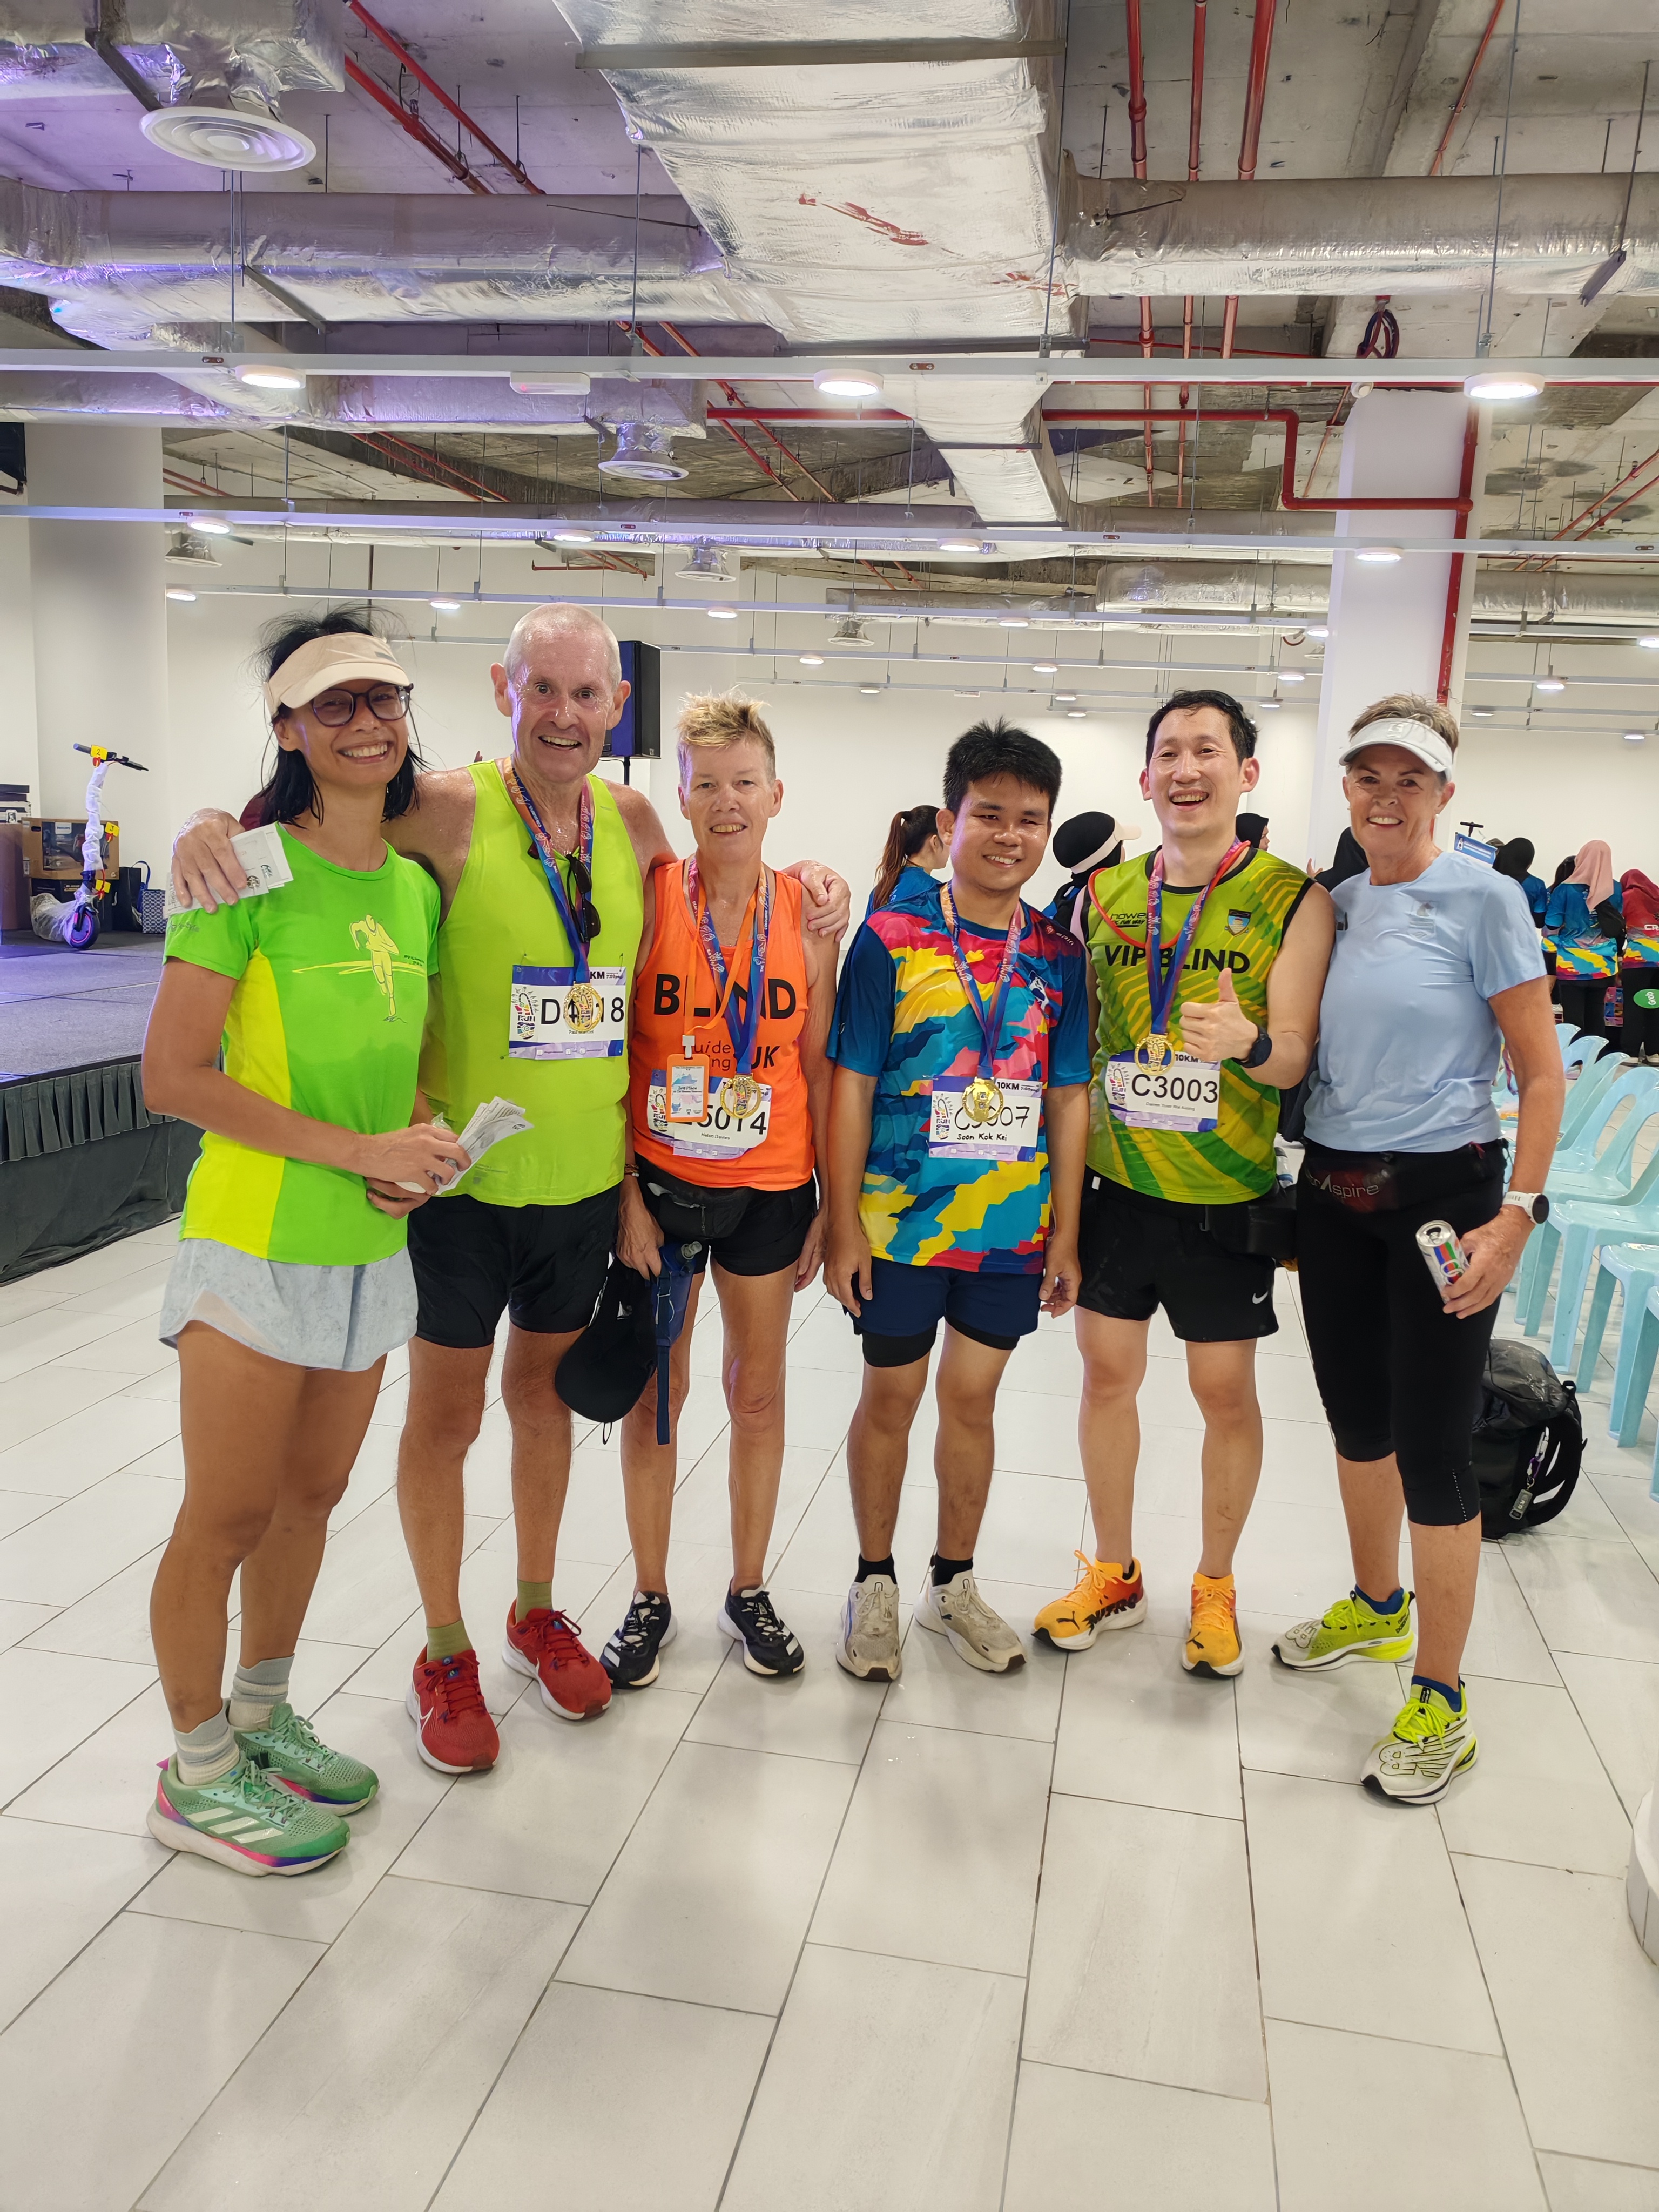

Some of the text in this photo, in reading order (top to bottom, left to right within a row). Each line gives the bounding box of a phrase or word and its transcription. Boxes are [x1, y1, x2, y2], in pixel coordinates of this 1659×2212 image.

[1105, 945, 1147, 967] VIP
[1645, 992, 1656, 1006] Grab
[541, 997, 624, 1024] D418
[684, 1040, 731, 1054] uide
[1175, 1054, 1198, 1063] 10KM
[997, 1082, 1020, 1090] 10KM
[1131, 1074, 1218, 1103] C3003
[683, 1105, 767, 1135] 5014
[978, 1132, 993, 1141] Kok
